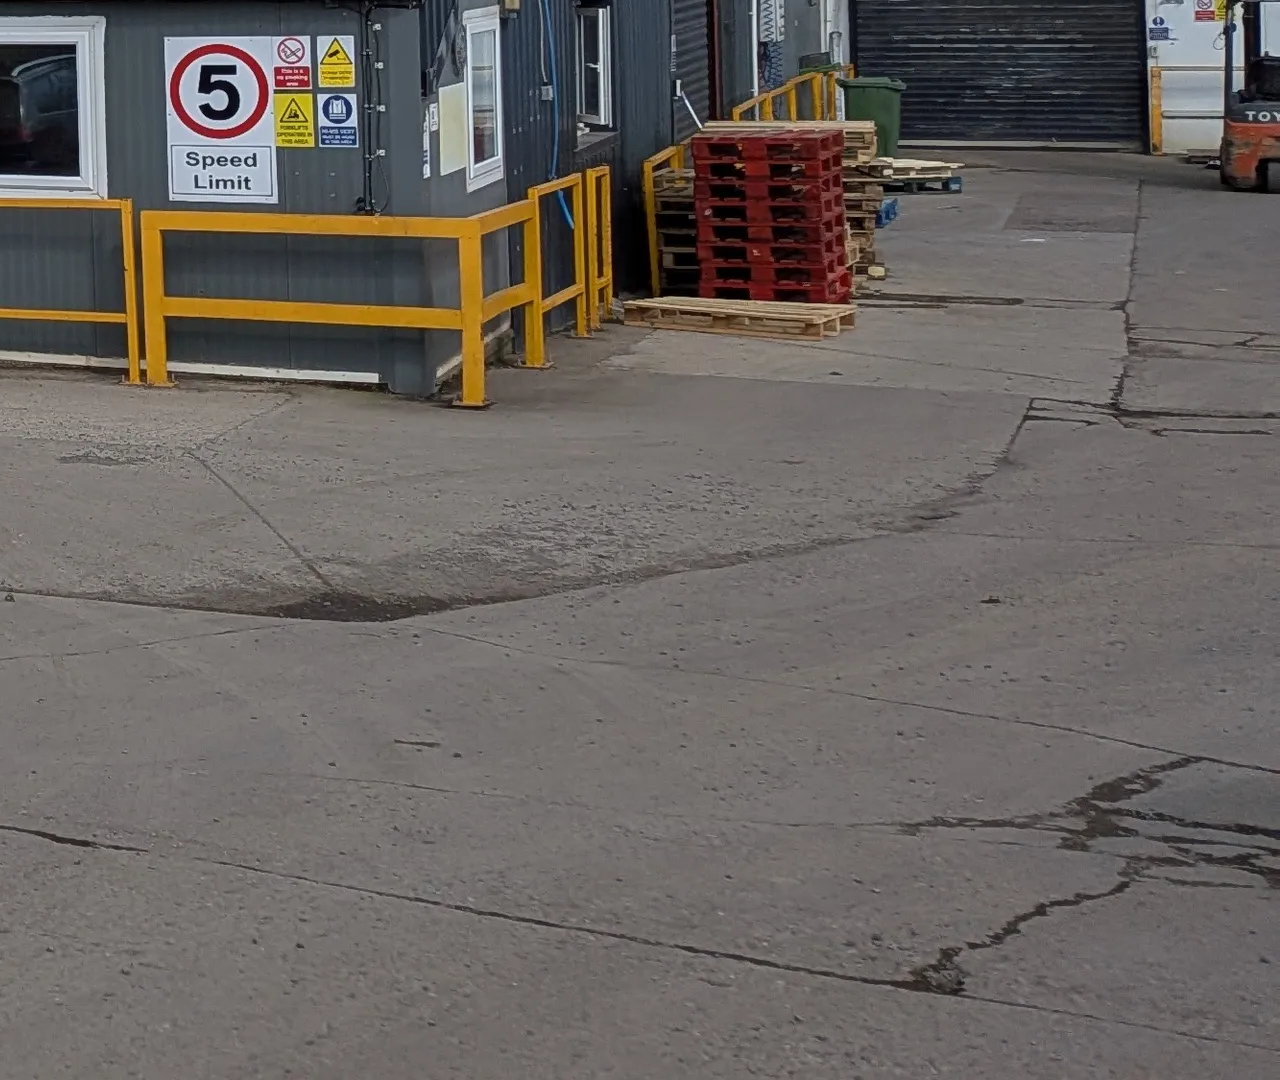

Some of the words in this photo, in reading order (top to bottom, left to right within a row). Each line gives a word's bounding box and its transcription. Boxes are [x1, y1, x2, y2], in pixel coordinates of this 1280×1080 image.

[198, 65, 240, 121] 5
[185, 151, 257, 170] Speed
[194, 175, 251, 190] Limit
